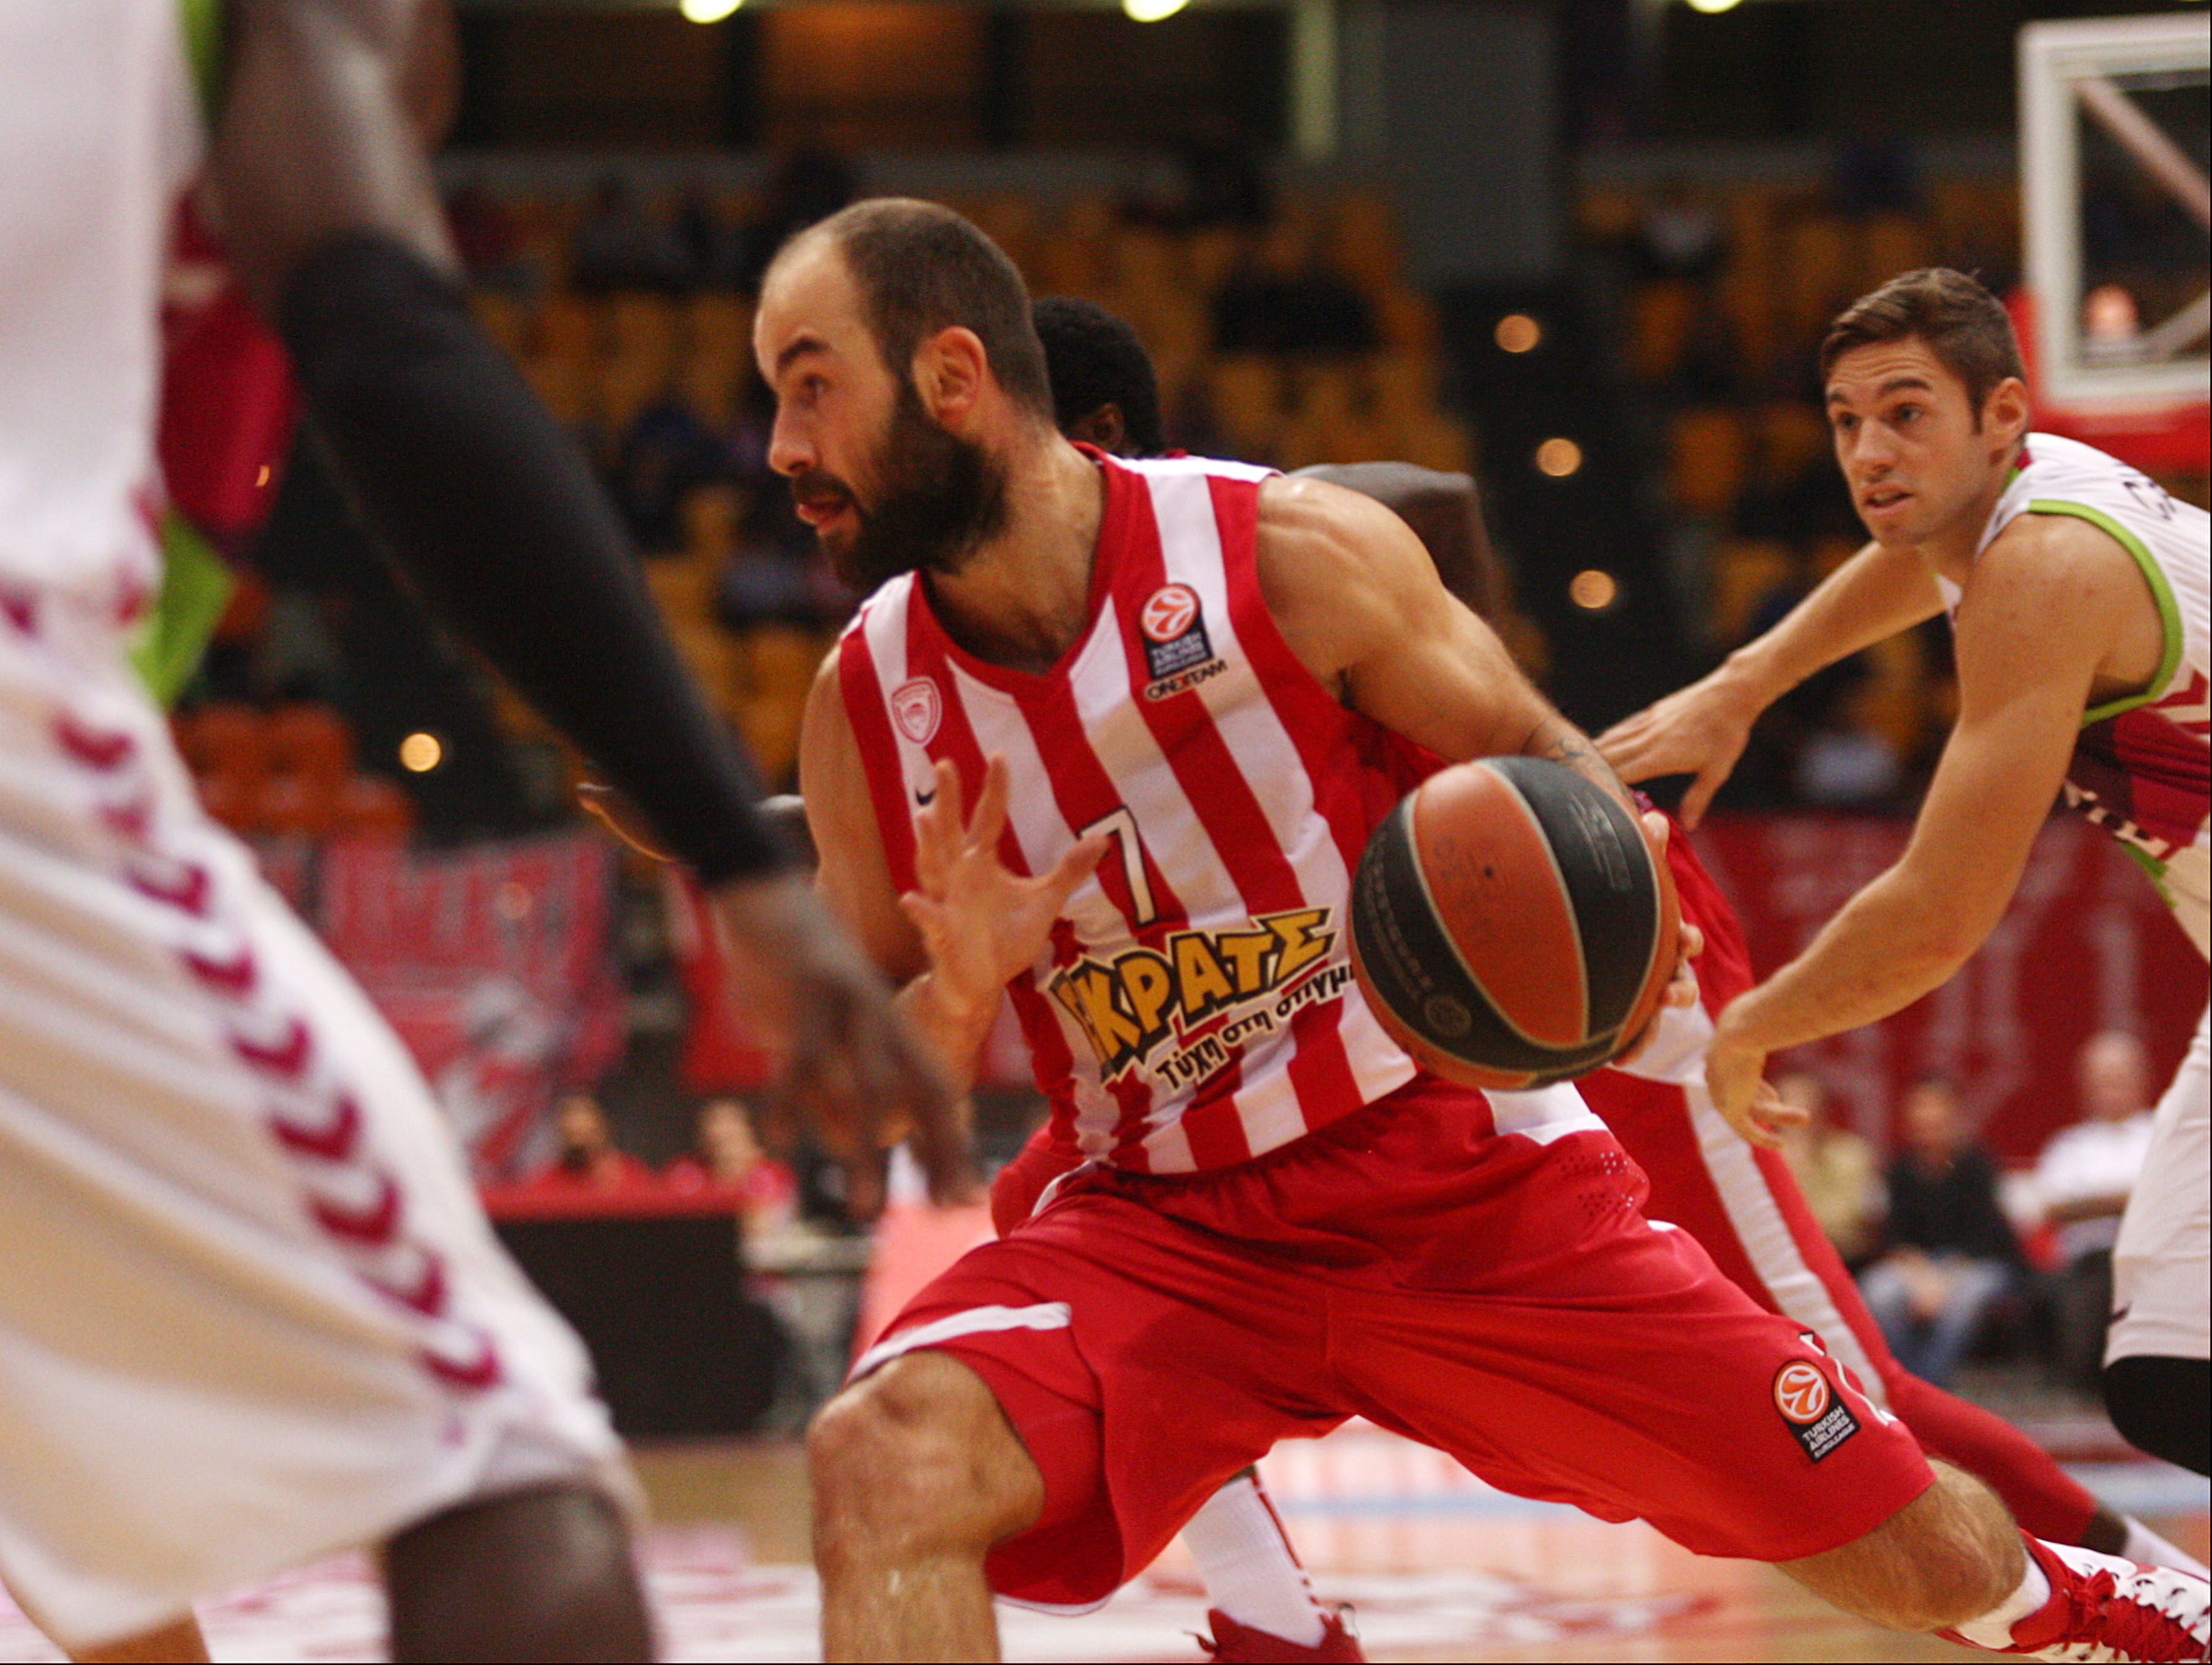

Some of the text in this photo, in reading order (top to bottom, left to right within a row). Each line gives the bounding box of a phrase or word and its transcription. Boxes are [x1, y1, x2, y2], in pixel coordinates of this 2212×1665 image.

[1077, 805, 1157, 927] 7
[1155, 965, 1354, 1090] Τύχη στη στιγμ
[1802, 1405, 1845, 1442] TURKISH
[1809, 1414, 1851, 1451] AIRLINES
